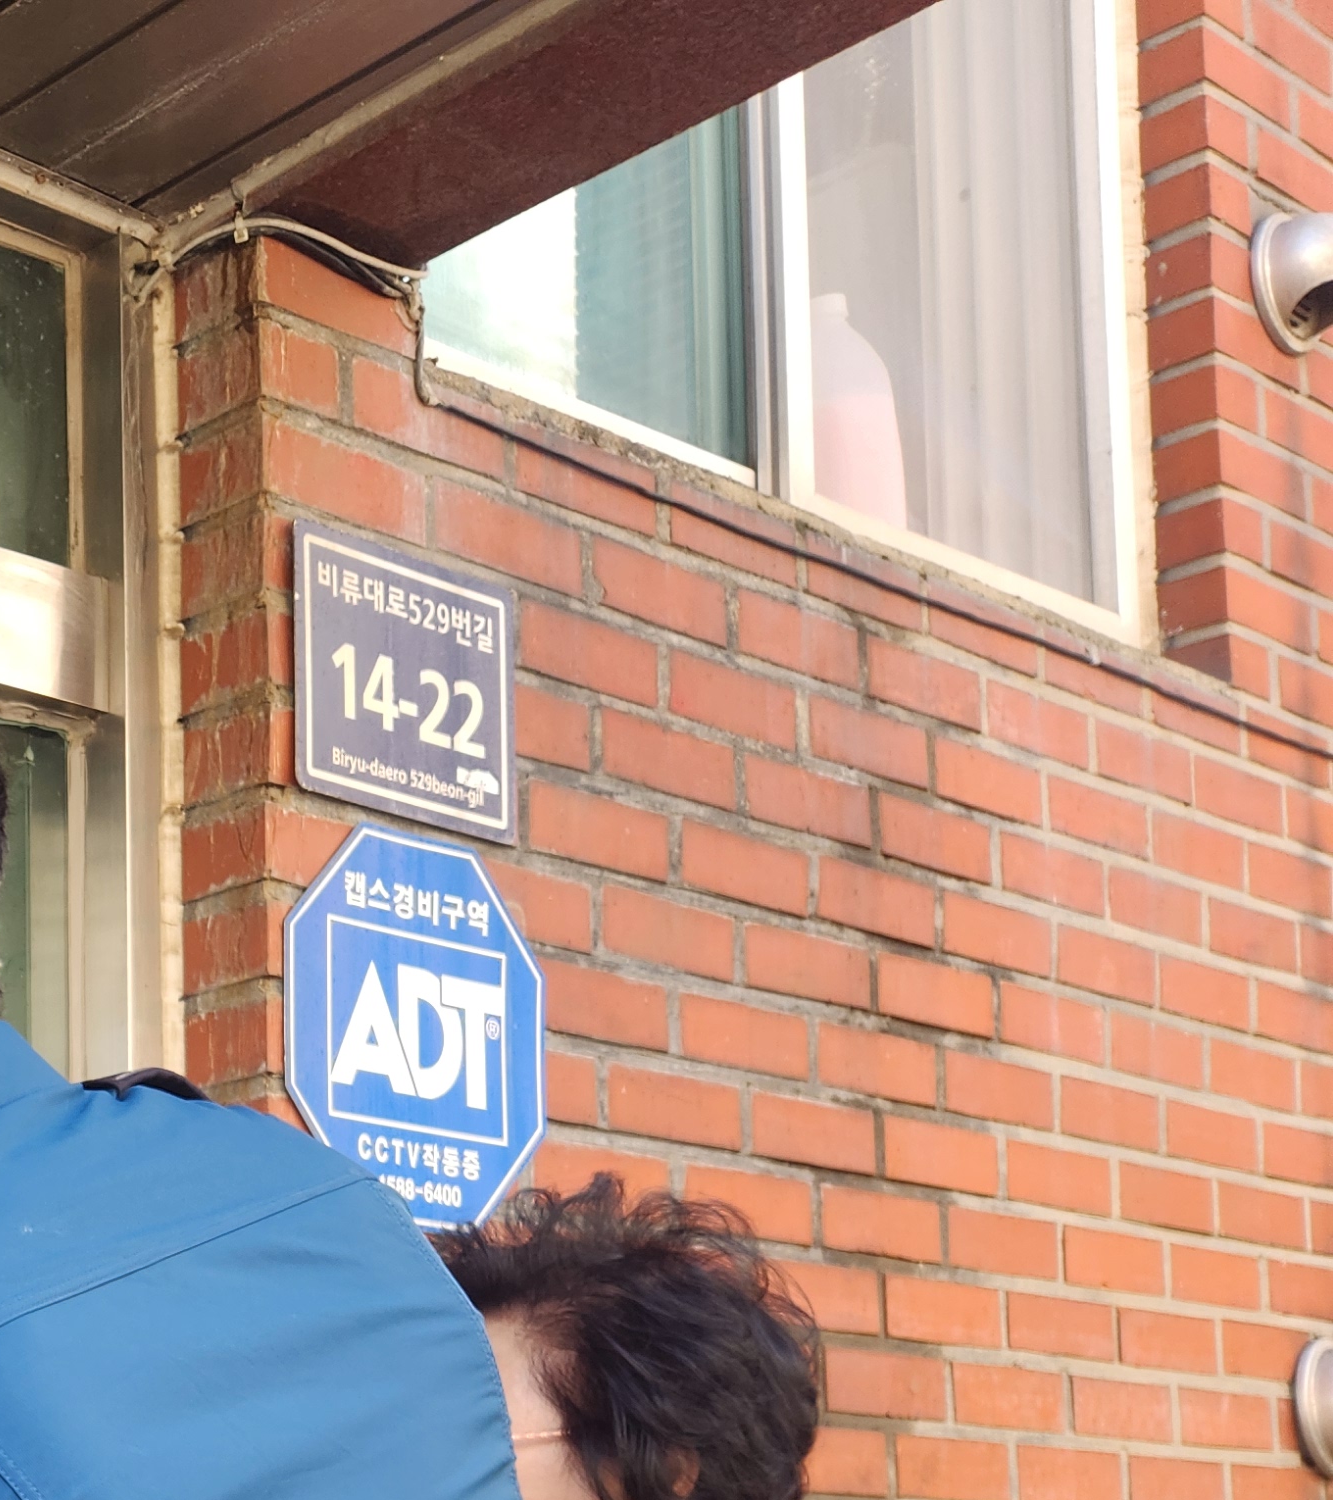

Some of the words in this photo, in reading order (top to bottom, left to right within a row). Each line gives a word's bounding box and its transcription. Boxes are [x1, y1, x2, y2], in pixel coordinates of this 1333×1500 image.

[318, 561, 493, 653] 비류대로529번길
[331, 642, 486, 759] 14-22
[332, 746, 407, 786] Biryu-daero
[344, 870, 489, 936] 캡스경비구역
[331, 960, 504, 1110] ADT
[358, 1133, 481, 1181] CCTV작동중
